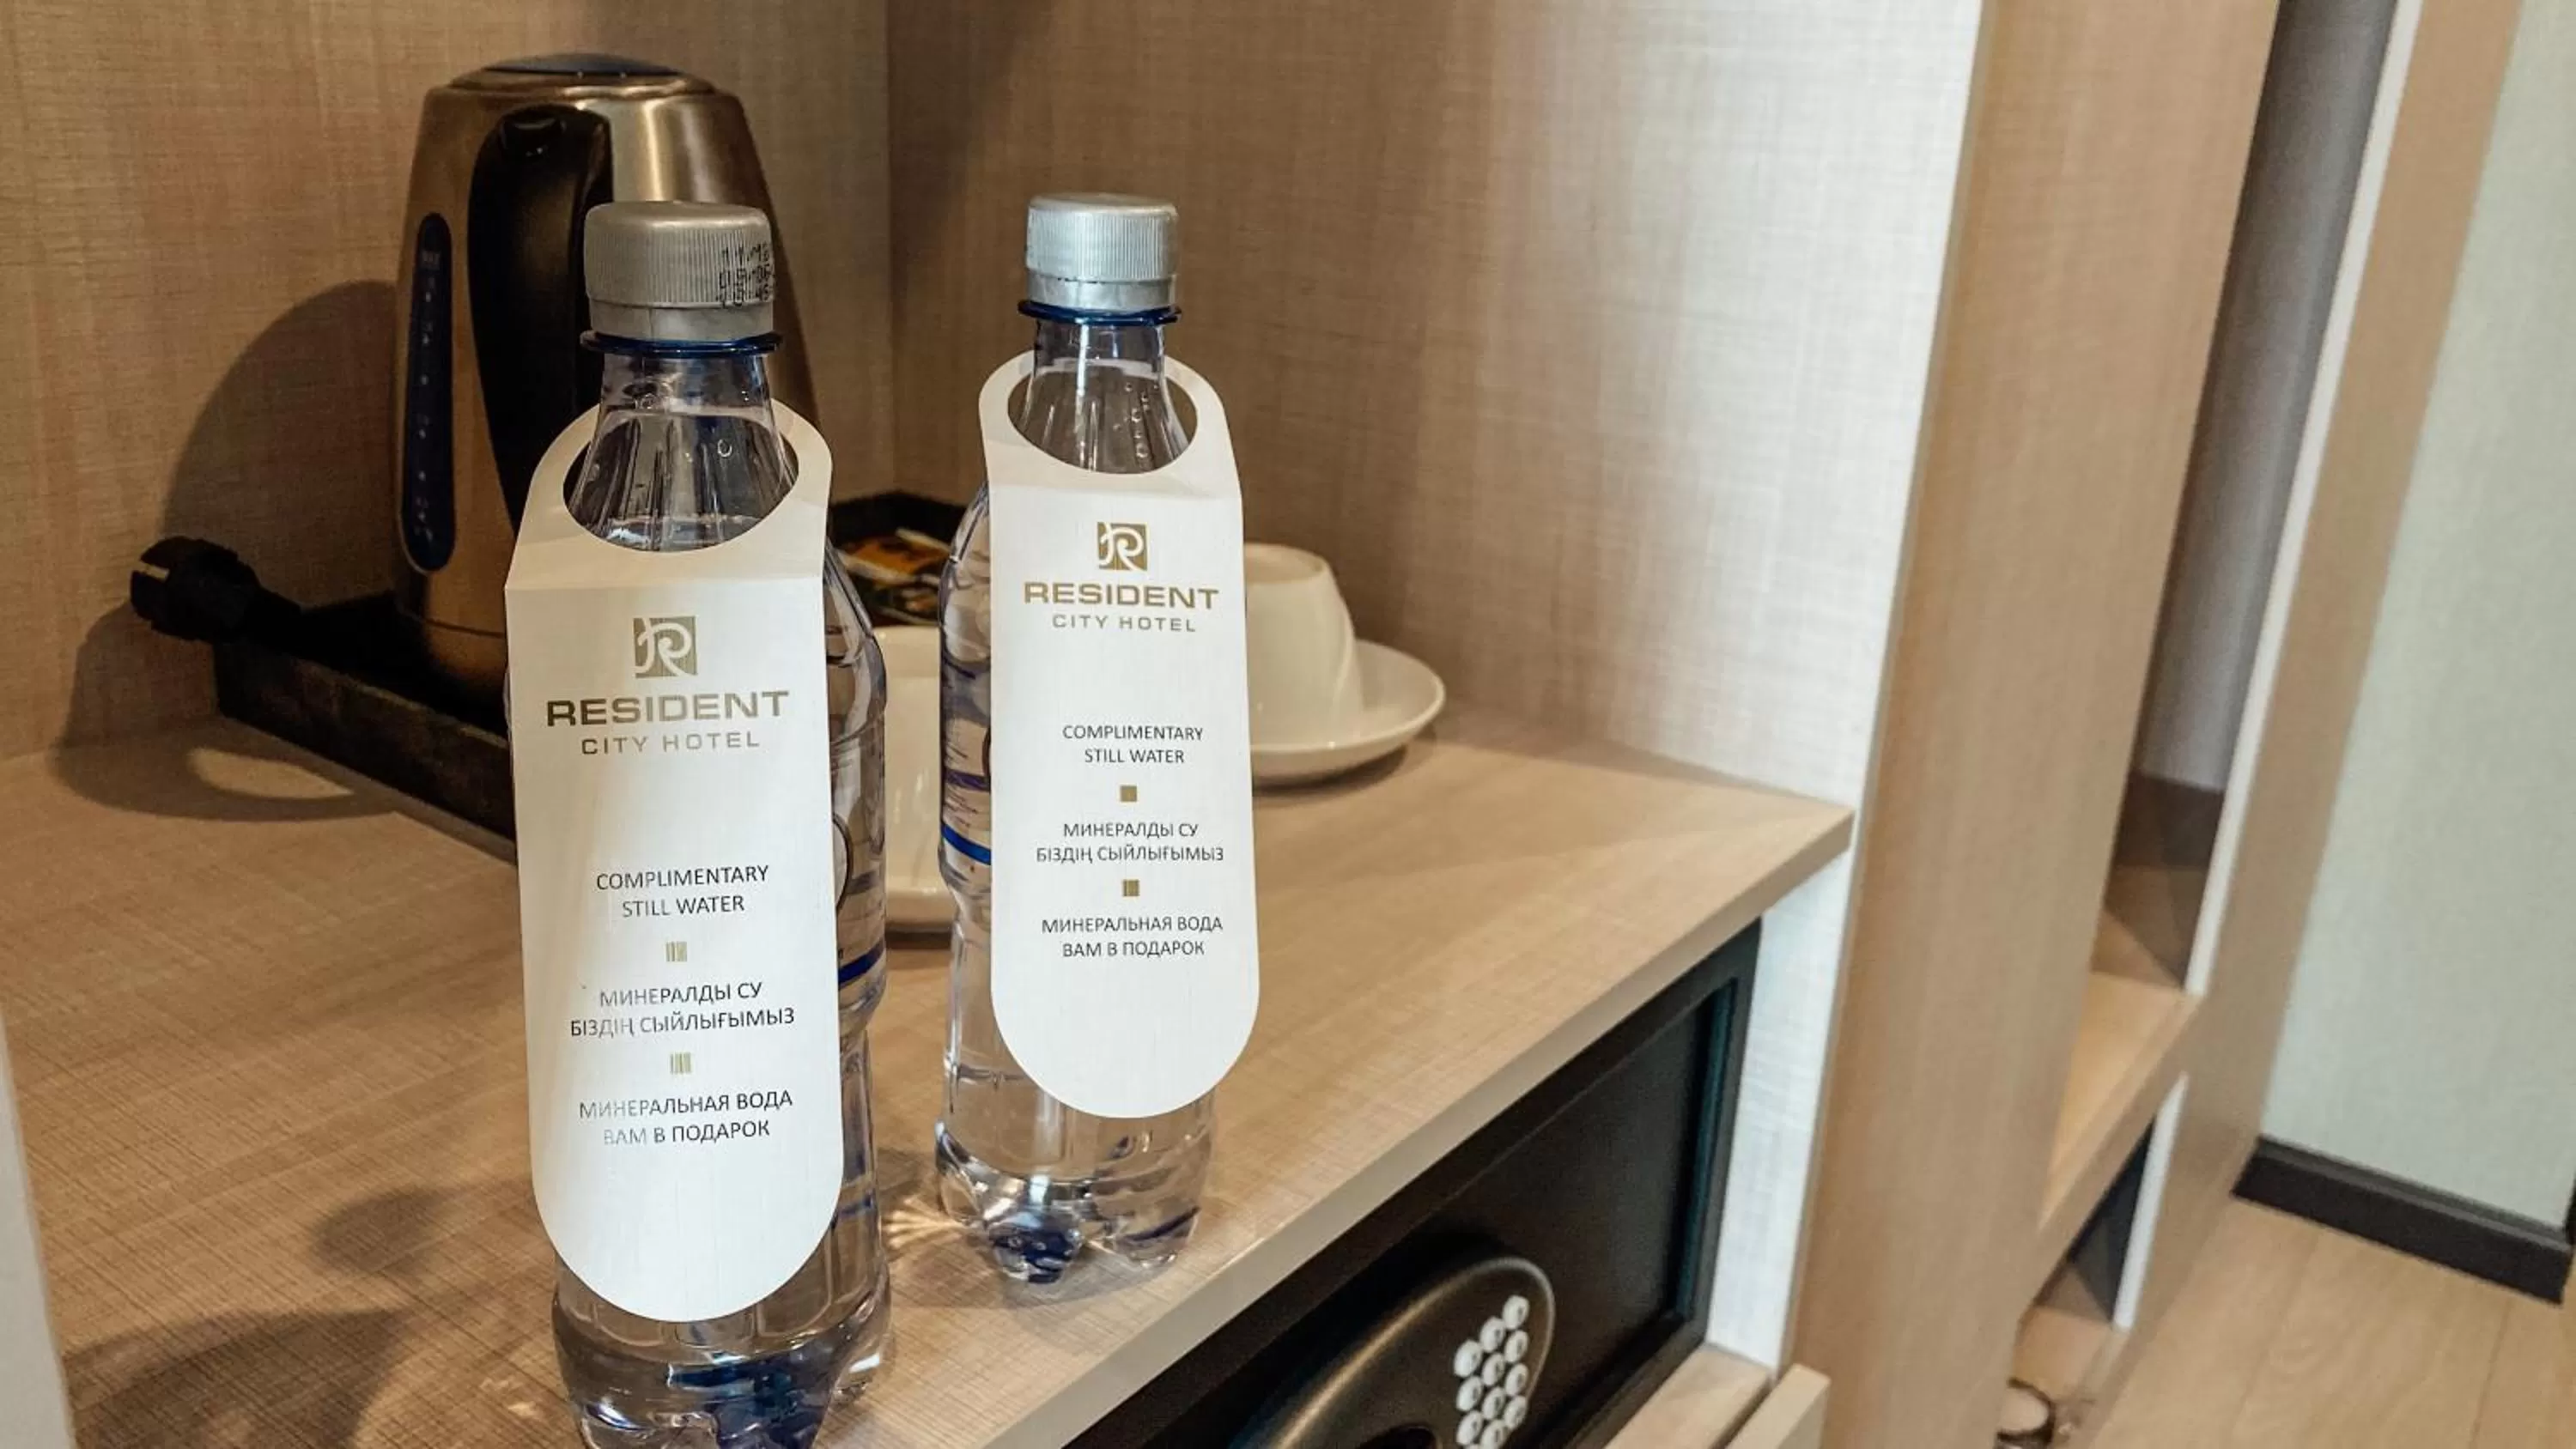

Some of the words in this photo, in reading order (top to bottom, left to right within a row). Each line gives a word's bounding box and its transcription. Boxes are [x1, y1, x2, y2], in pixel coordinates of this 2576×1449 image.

[1024, 581, 1219, 610] RESIDENT
[1052, 613, 1109, 629] CITY
[1118, 616, 1196, 633] HOTEL
[546, 690, 790, 728] RESIDENT
[581, 736, 649, 755] CITY
[662, 731, 760, 753] HOTEL
[1061, 724, 1204, 741] COMPLIMENTARY
[1084, 748, 1126, 763] STILL
[1129, 749, 1185, 764] WATER
[1062, 822, 1174, 839] МИНЕРАЛДЫ
[1177, 823, 1200, 837] СУ
[596, 864, 770, 890] COMPLIMENTARY
[622, 899, 671, 918] STILL
[675, 894, 745, 915] WATER
[1041, 916, 1173, 934] МИНЕРАЛЬНАЯ
[1177, 916, 1224, 933] ВОДА
[1062, 942, 1102, 957] ВАМ
[1107, 942, 1118, 956] В
[1122, 940, 1205, 959] ПОДАРОК
[599, 984, 732, 1008] МИНЕРАЛДЫ
[737, 981, 763, 999] СУ
[579, 1094, 730, 1120] МИНЕРАЛЬНАЯ
[736, 1088, 793, 1112] ВОДА
[603, 1126, 647, 1146] ВАМ
[653, 1126, 666, 1144] В
[671, 1119, 771, 1144] ПОДАРОК
